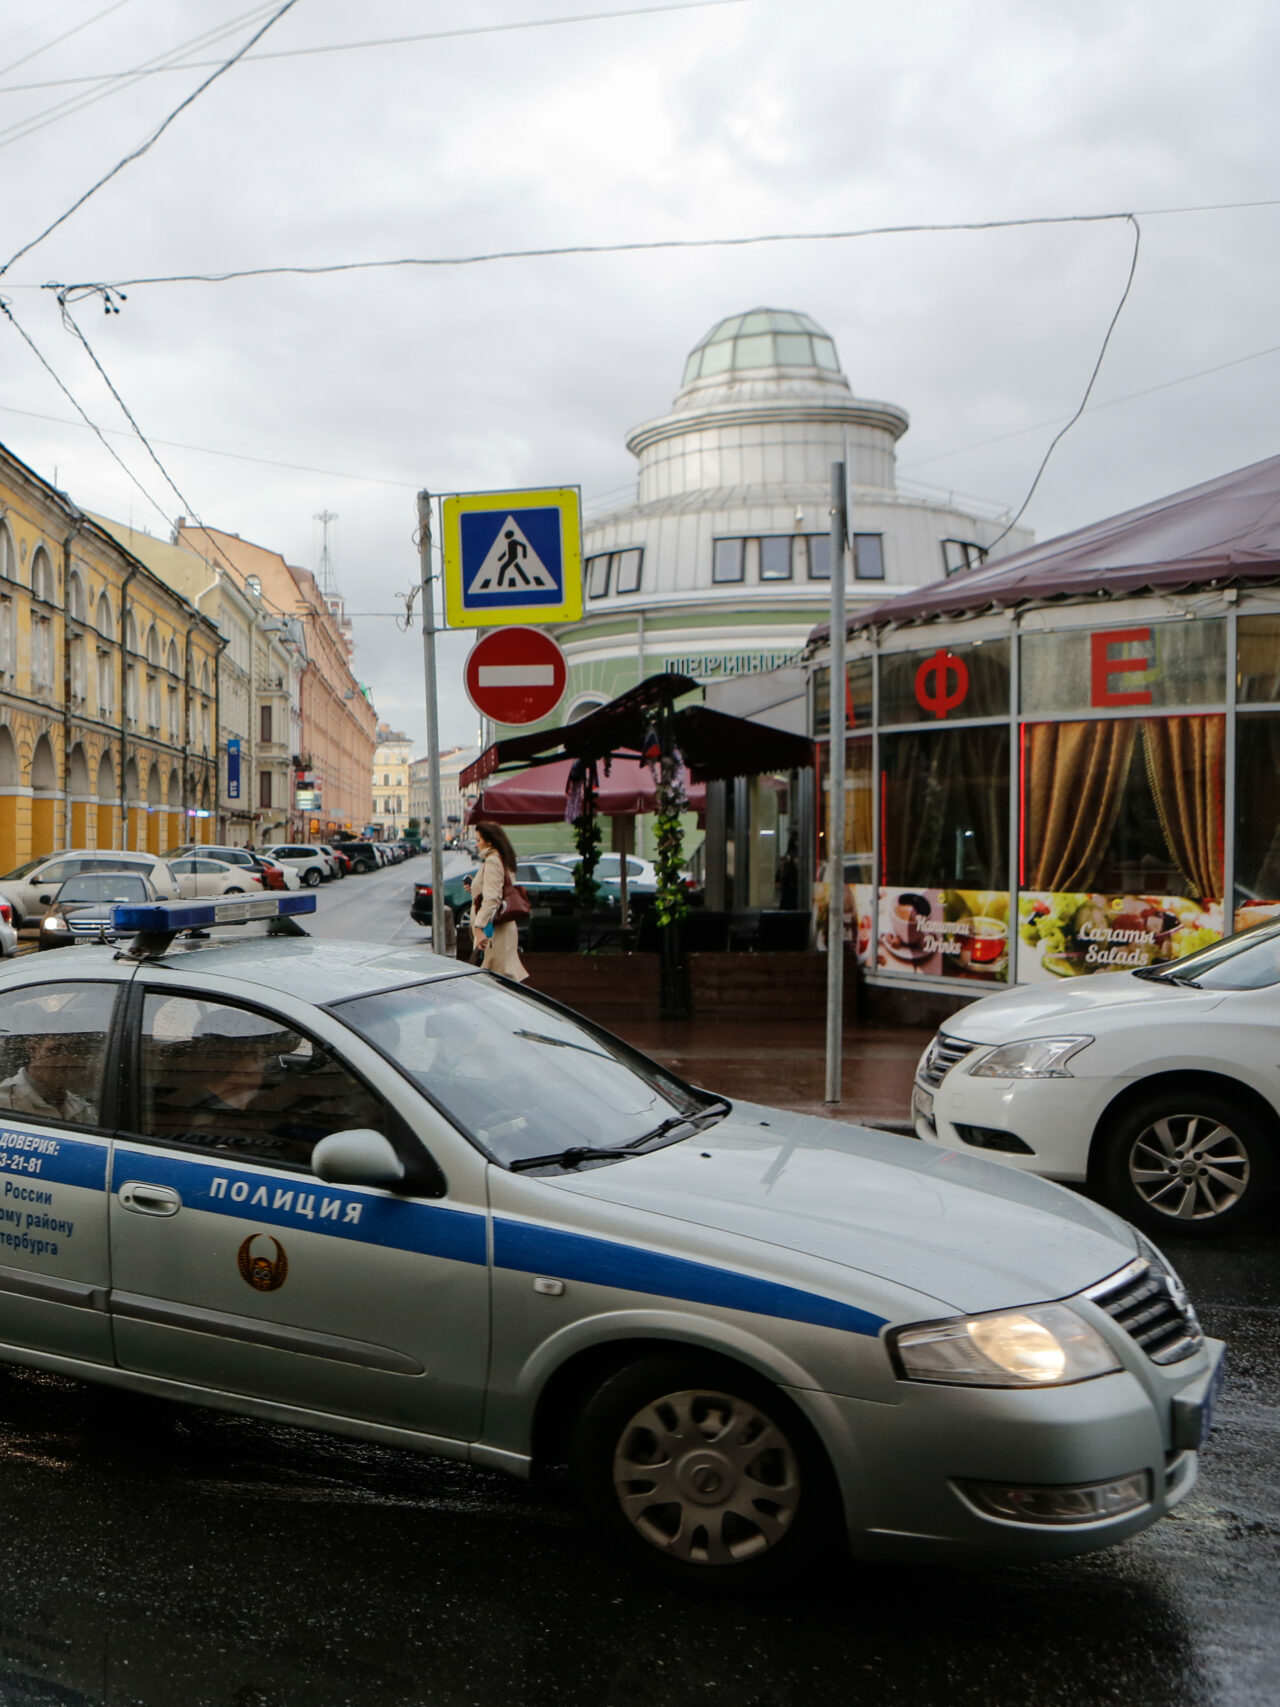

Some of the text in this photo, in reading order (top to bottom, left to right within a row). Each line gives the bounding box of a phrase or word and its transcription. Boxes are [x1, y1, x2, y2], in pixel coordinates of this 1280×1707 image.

[229, 780, 238, 797] ВТБ
[923, 935, 962, 955] Drinks
[1077, 921, 1156, 945] Салаты
[1085, 943, 1149, 967] Salads
[4, 1181, 53, 1206] России
[209, 1177, 364, 1225] ПОЛИЦИЯ
[26, 1213, 75, 1239] району
